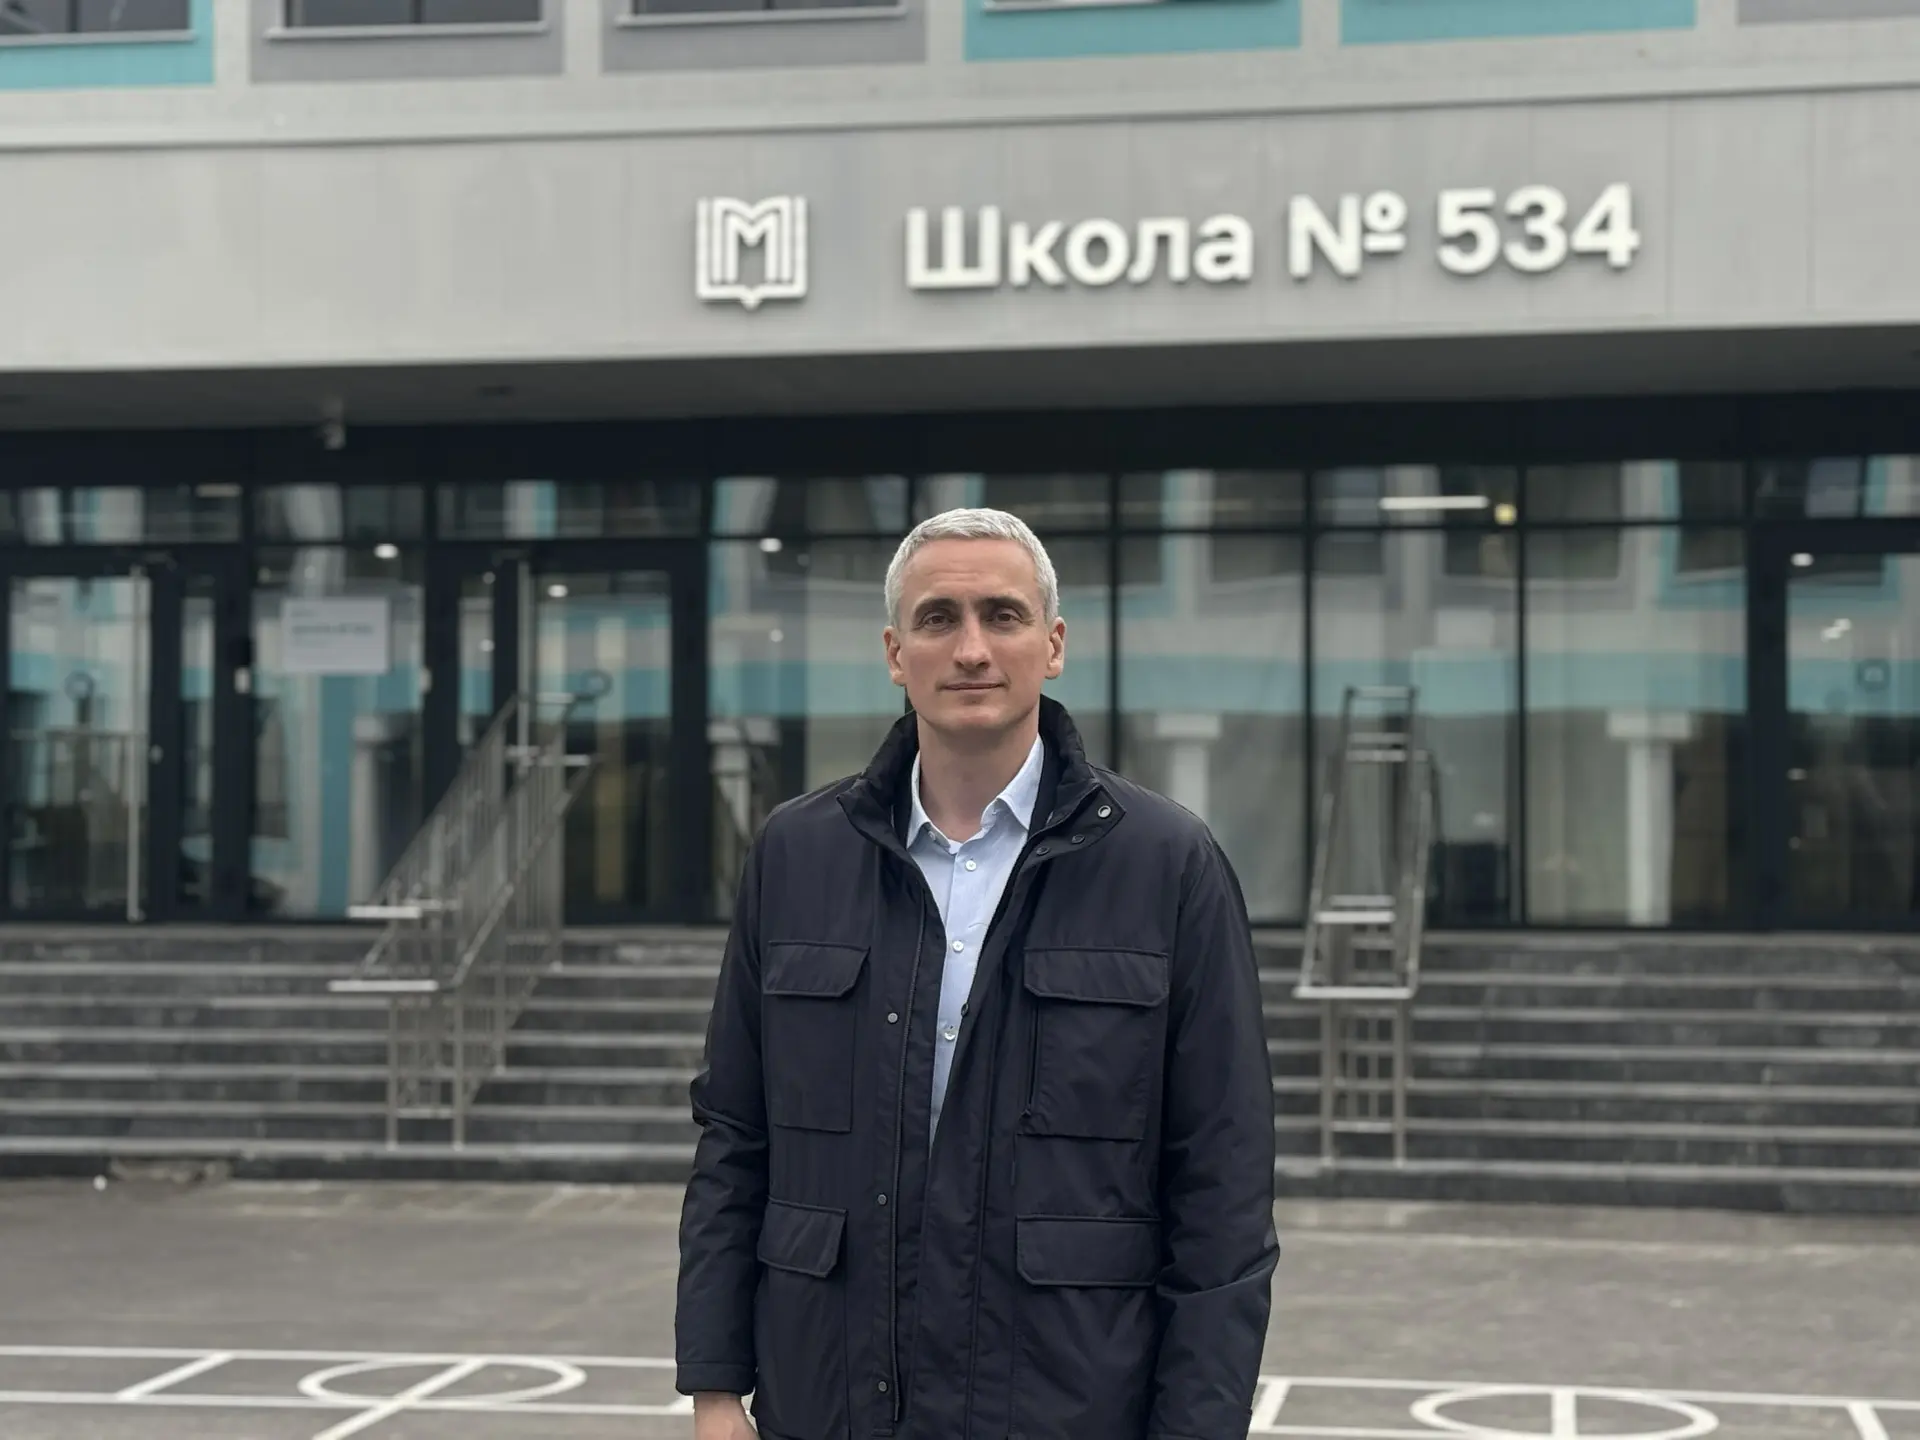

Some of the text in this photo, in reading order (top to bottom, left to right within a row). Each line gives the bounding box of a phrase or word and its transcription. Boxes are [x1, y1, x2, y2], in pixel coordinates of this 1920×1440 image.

[907, 183, 1640, 288] Школа № 534
